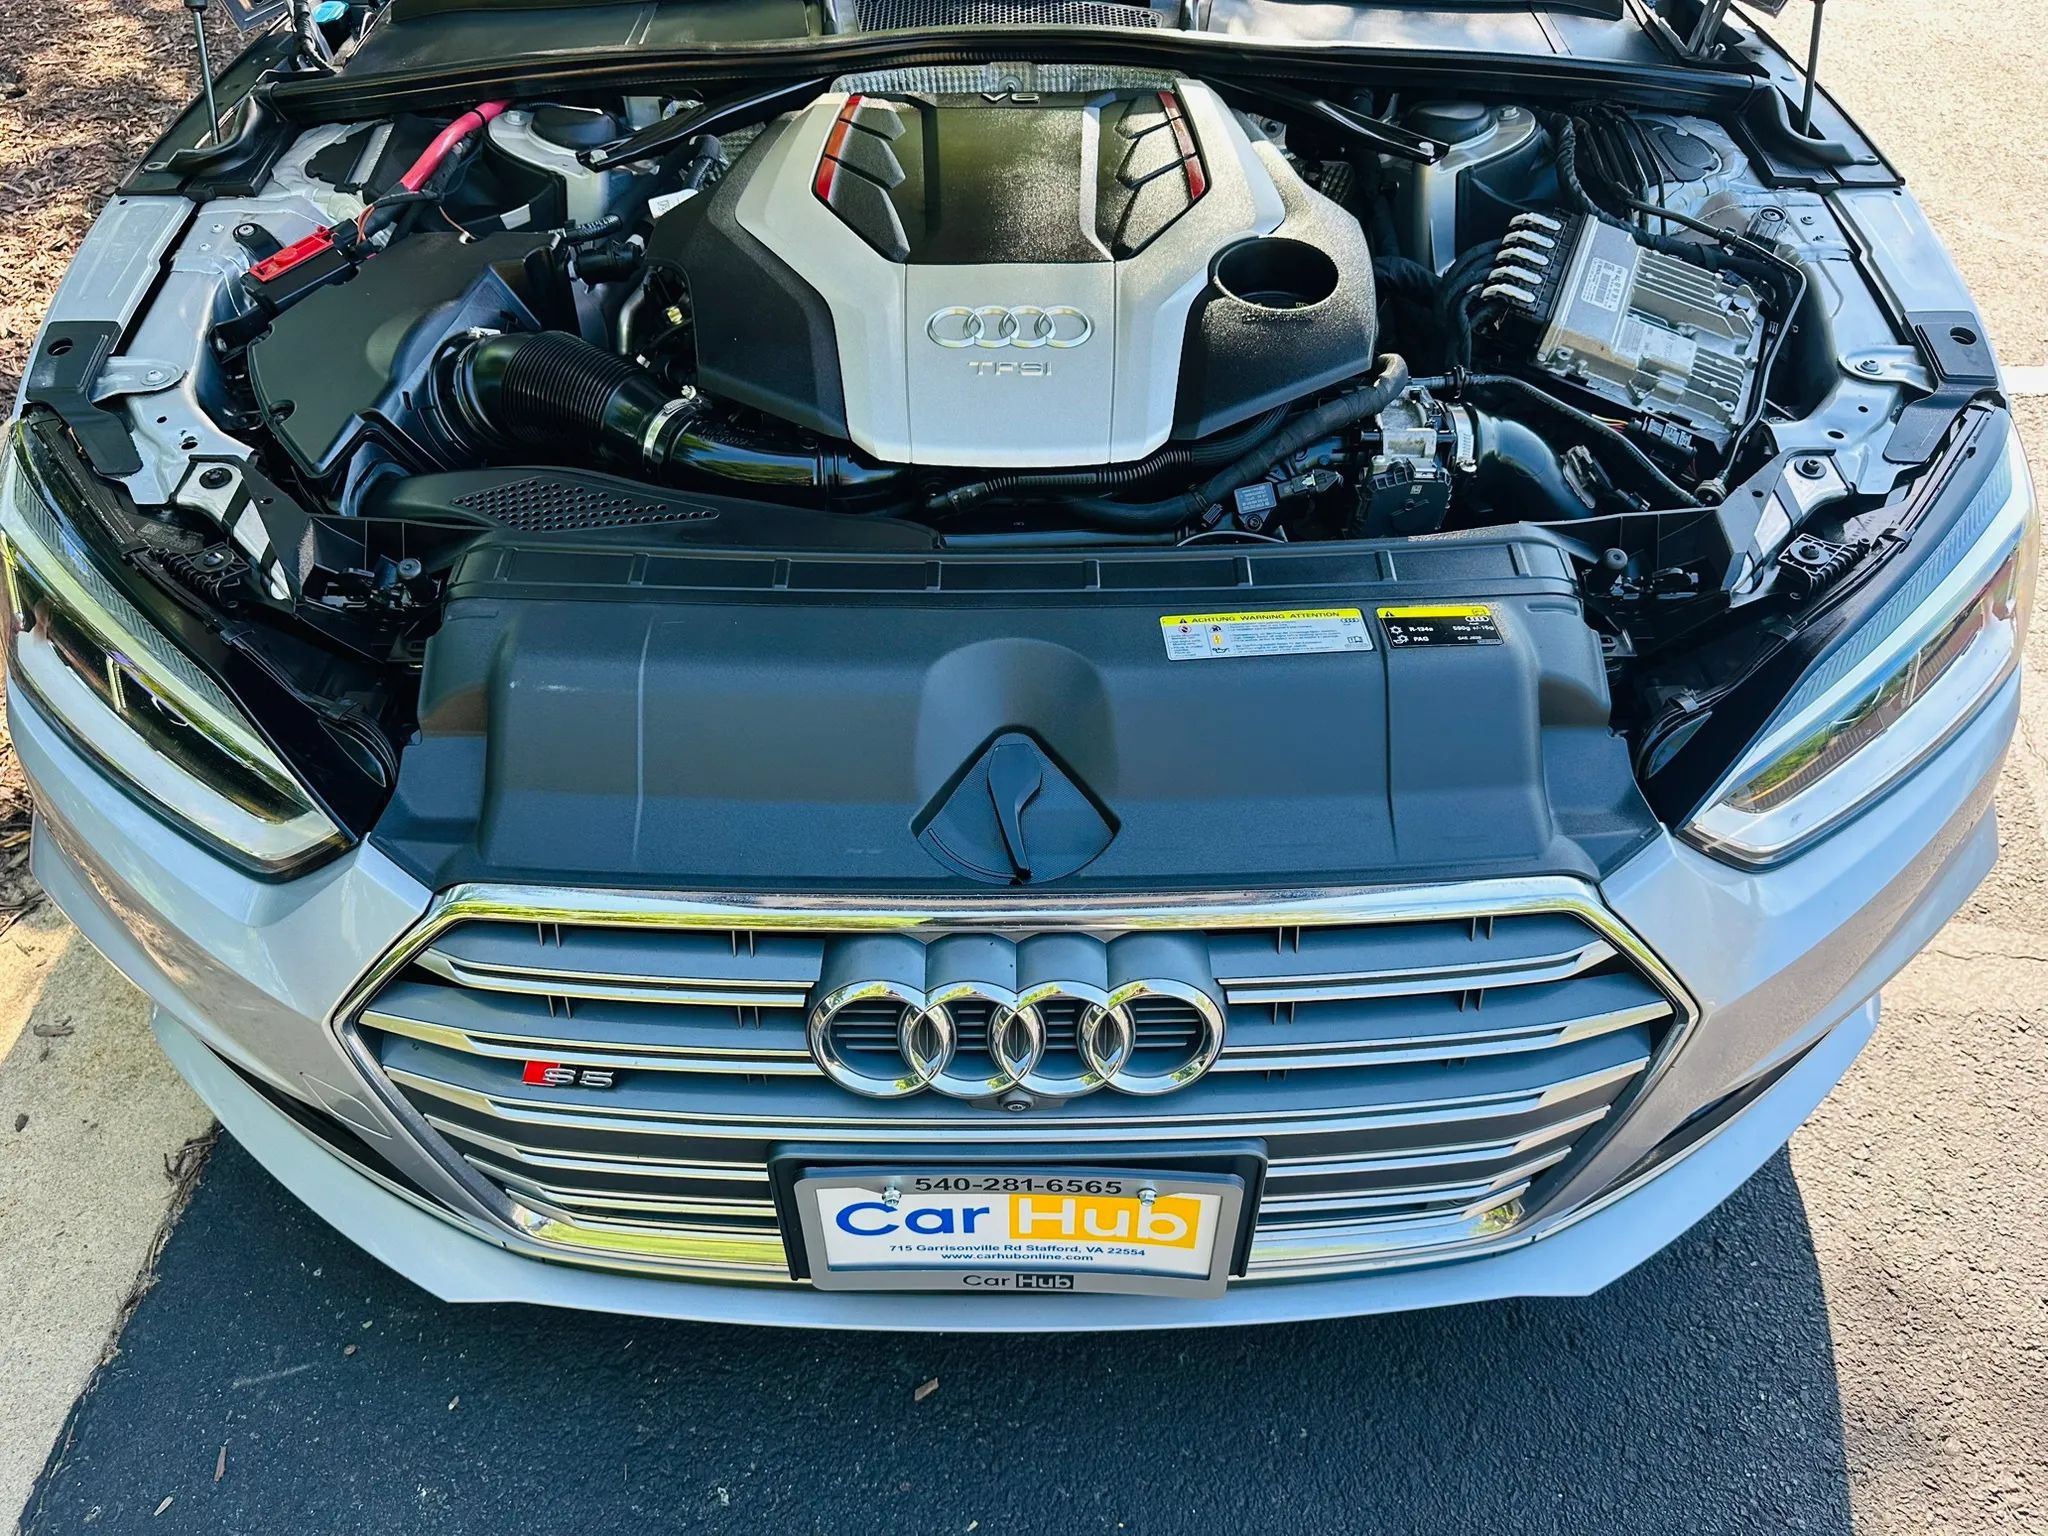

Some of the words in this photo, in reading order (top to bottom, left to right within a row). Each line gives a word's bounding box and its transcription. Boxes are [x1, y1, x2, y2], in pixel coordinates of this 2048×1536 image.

[968, 361, 1052, 376] TFSI
[543, 1068, 614, 1087] S5
[915, 1177, 1122, 1194] 540-281-6565
[836, 1201, 990, 1236] Car
[1018, 1197, 1188, 1241] Hub
[916, 1244, 1000, 1252] Garrisonville
[1004, 1244, 1022, 1252] Rd
[1026, 1244, 1082, 1254] Stafford,
[1086, 1246, 1104, 1254] VA
[1107, 1247, 1145, 1256] 22554
[941, 1252, 1094, 1261] www.carhubonline.com
[962, 1274, 1010, 1286] Car
[1018, 1274, 1072, 1288] Hub
